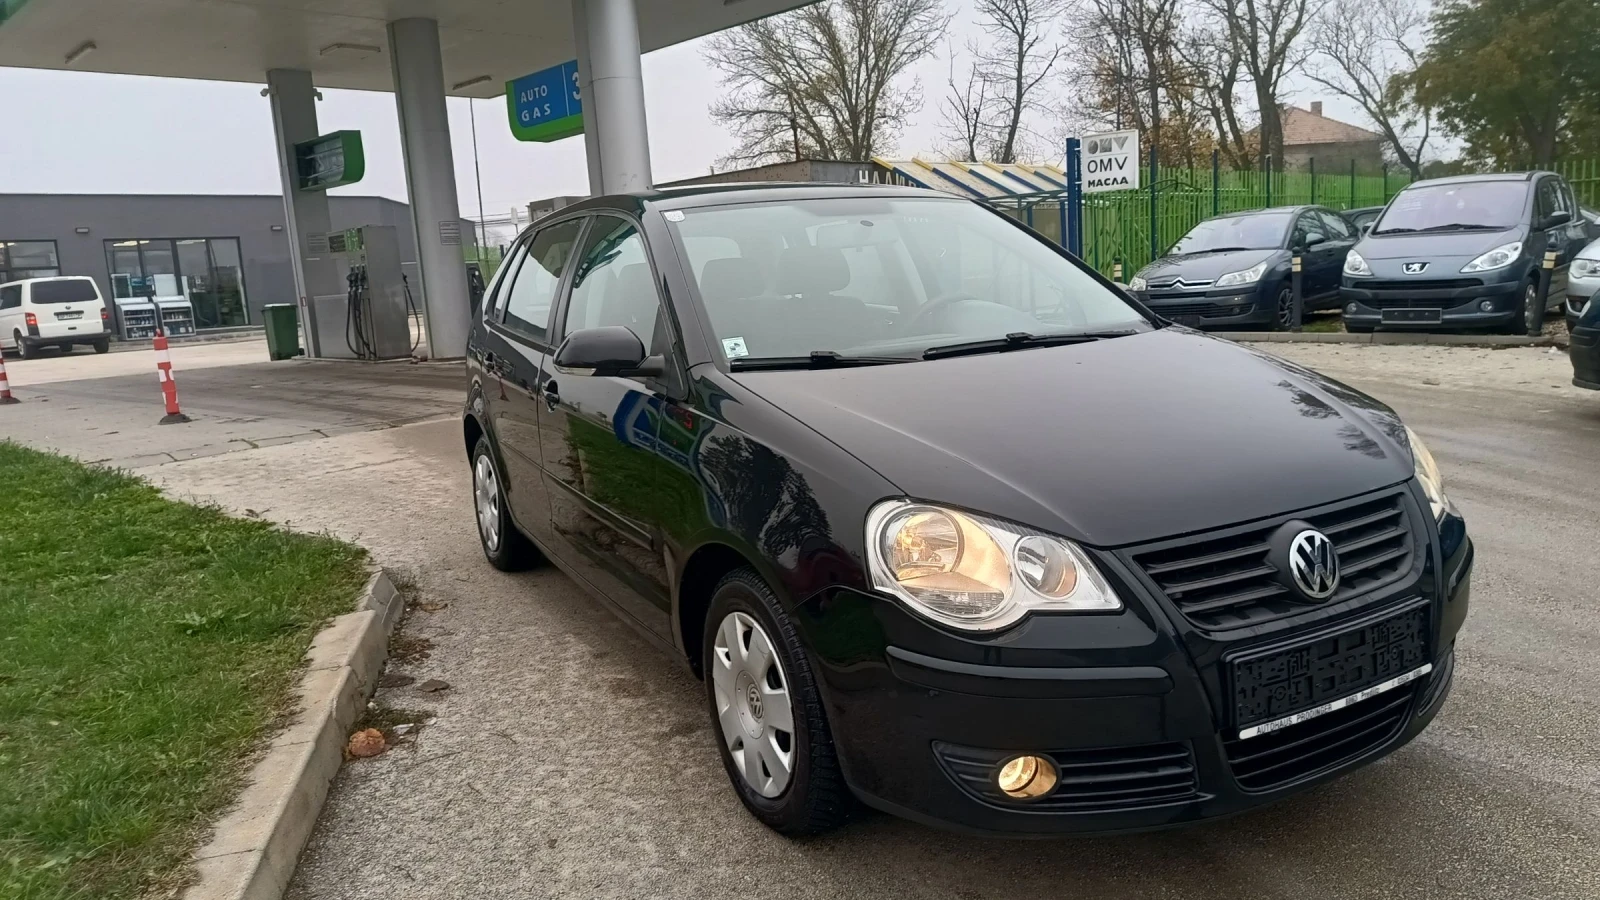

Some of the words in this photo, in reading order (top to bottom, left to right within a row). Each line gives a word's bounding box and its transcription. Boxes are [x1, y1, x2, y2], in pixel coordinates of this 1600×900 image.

[520, 85, 548, 103] AUTO
[521, 103, 551, 121] GAS
[1087, 156, 1128, 173] OMV
[1087, 176, 1129, 188] МАСЛА
[1256, 716, 1293, 735] AUTOHAUS
